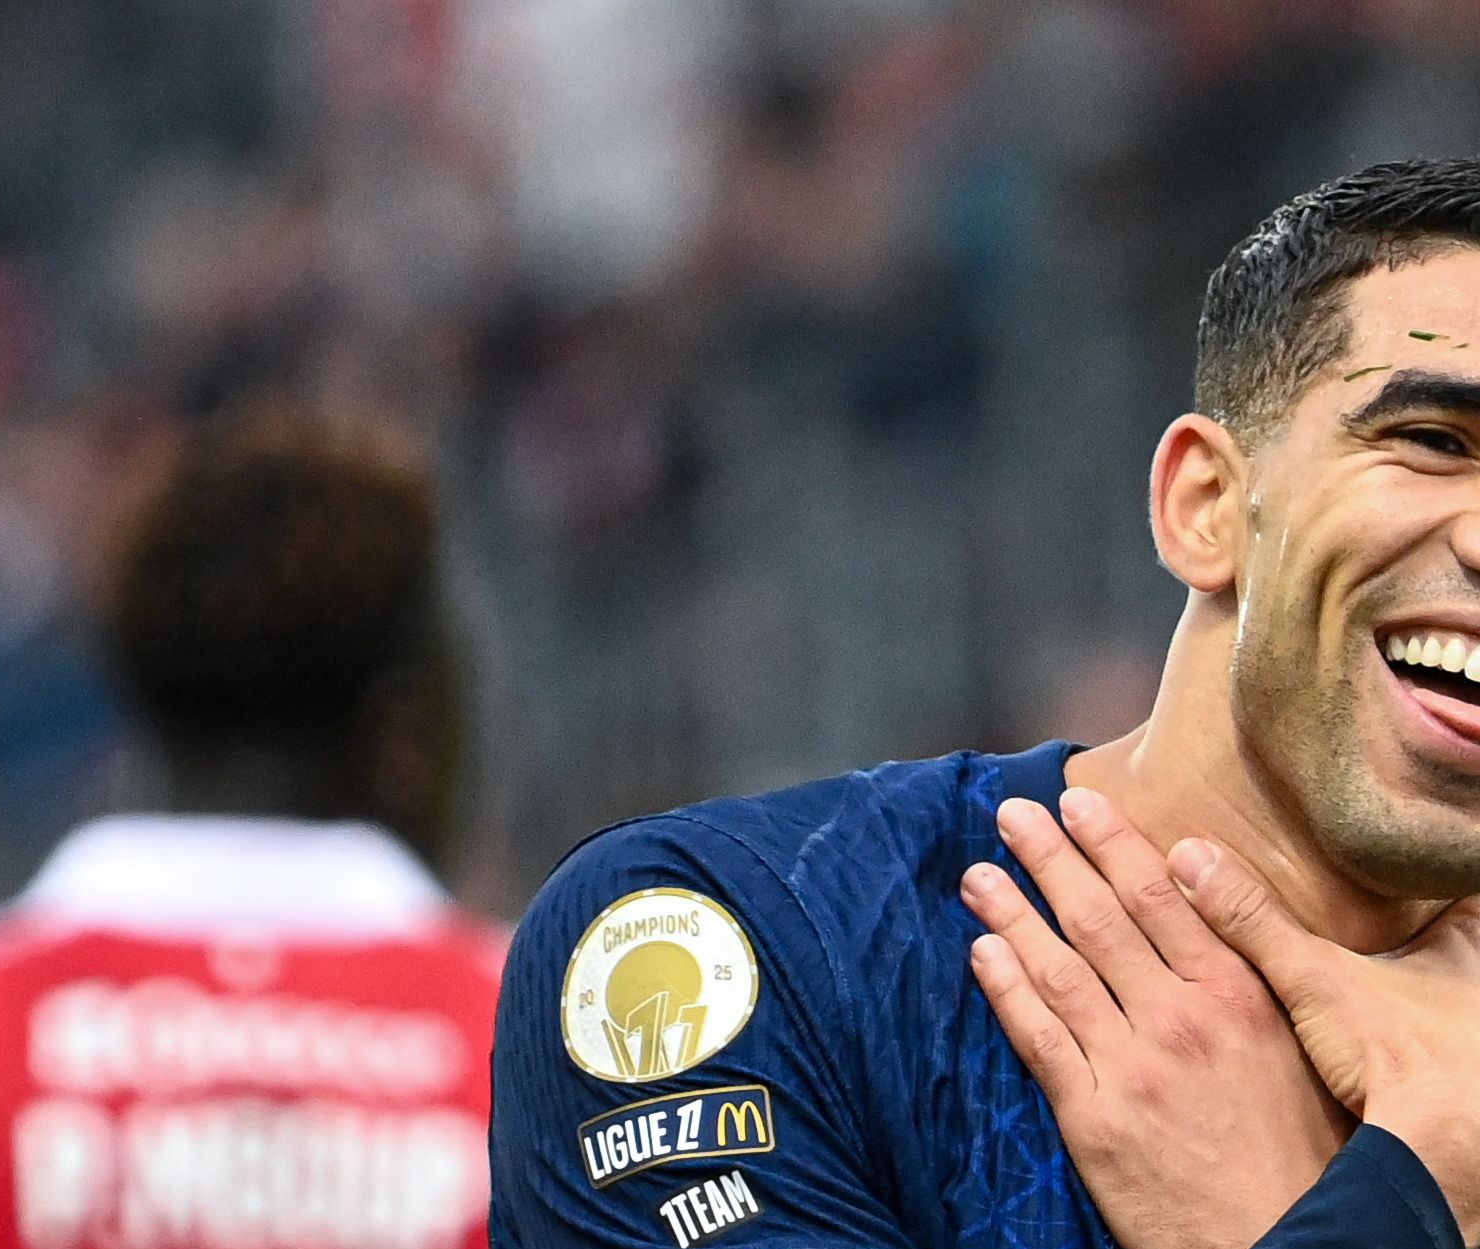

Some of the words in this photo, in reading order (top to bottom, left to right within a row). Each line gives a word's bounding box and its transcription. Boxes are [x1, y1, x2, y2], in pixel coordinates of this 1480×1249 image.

[603, 911, 700, 953] CHAMPIONS
[713, 964, 733, 981] 25
[584, 1111, 671, 1180] LIGUE
[659, 1170, 759, 1249] 1TEAM
